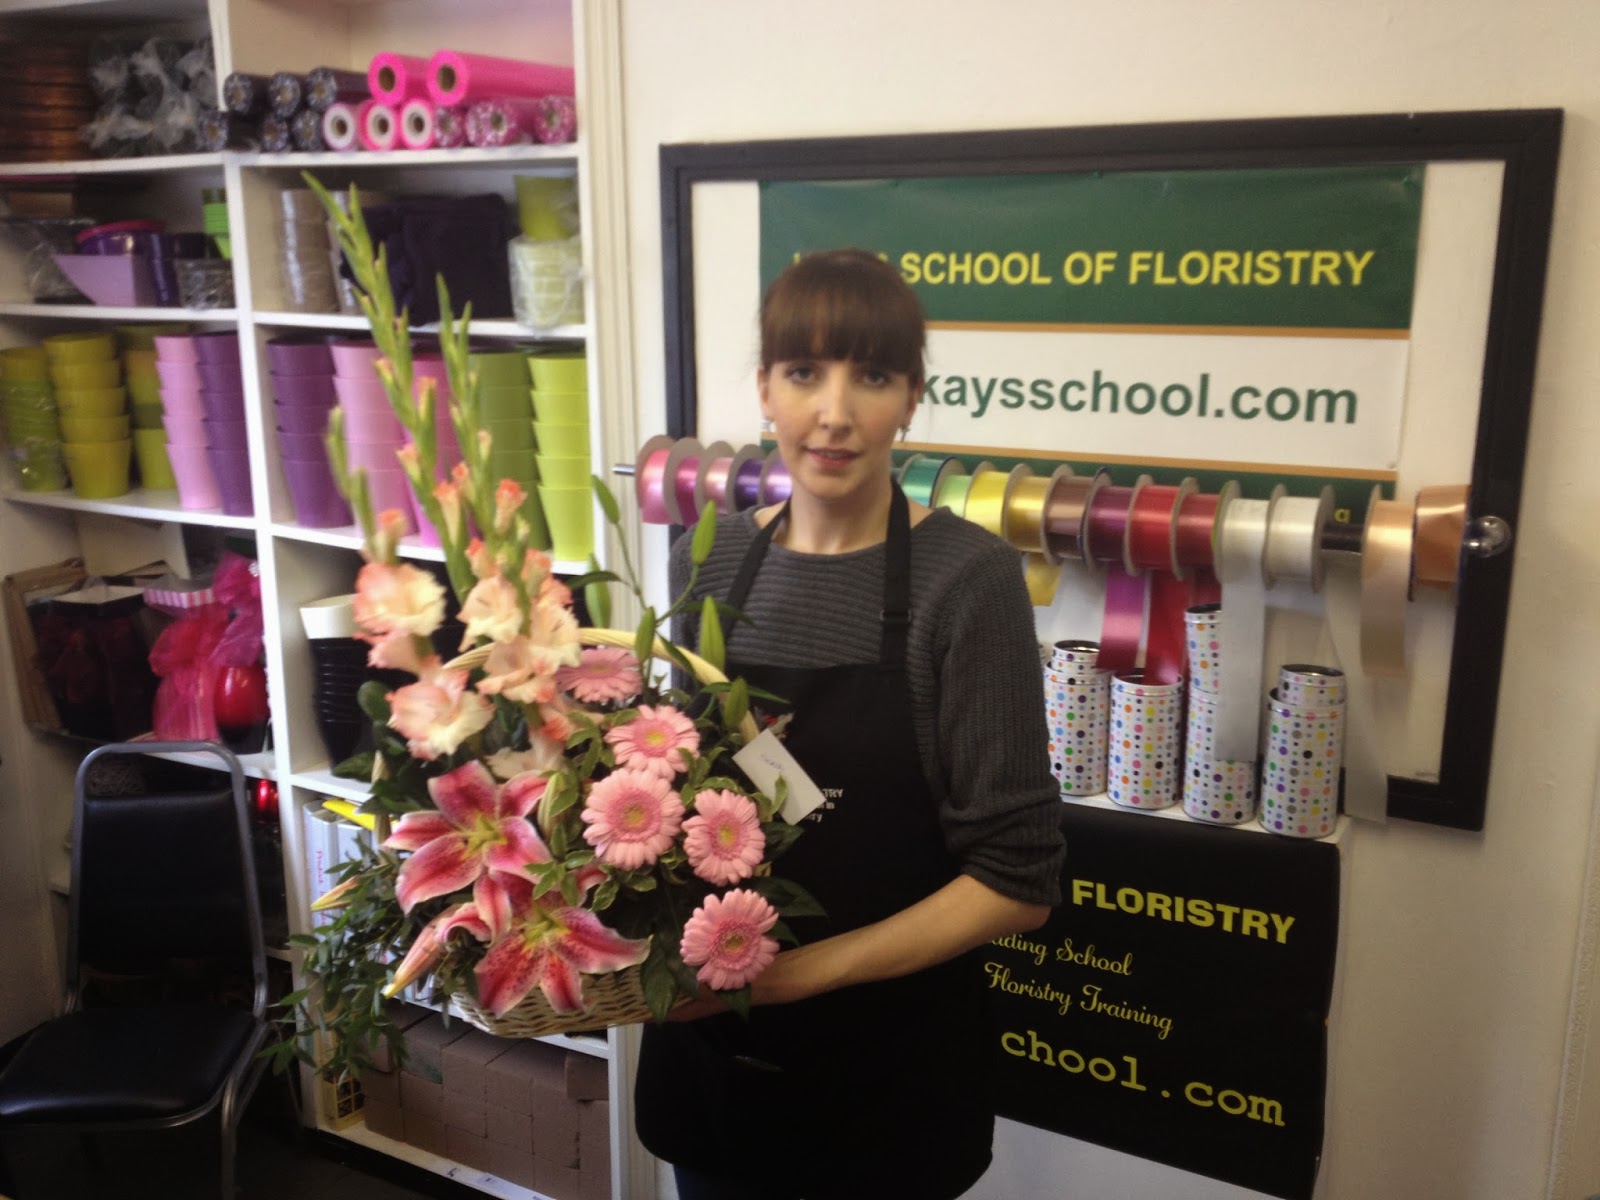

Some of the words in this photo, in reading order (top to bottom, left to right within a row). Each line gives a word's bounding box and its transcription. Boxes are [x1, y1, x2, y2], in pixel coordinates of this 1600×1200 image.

[900, 252, 1053, 286] SCHOOL
[1063, 252, 1118, 286] OF
[1128, 249, 1375, 288] FLORISTRY
[918, 369, 1359, 426] kaysschool.com
[1072, 878, 1296, 945] FLORISTRY
[1056, 938, 1133, 976] School
[984, 962, 1072, 1016] Floristry
[1080, 984, 1174, 1040] Training
